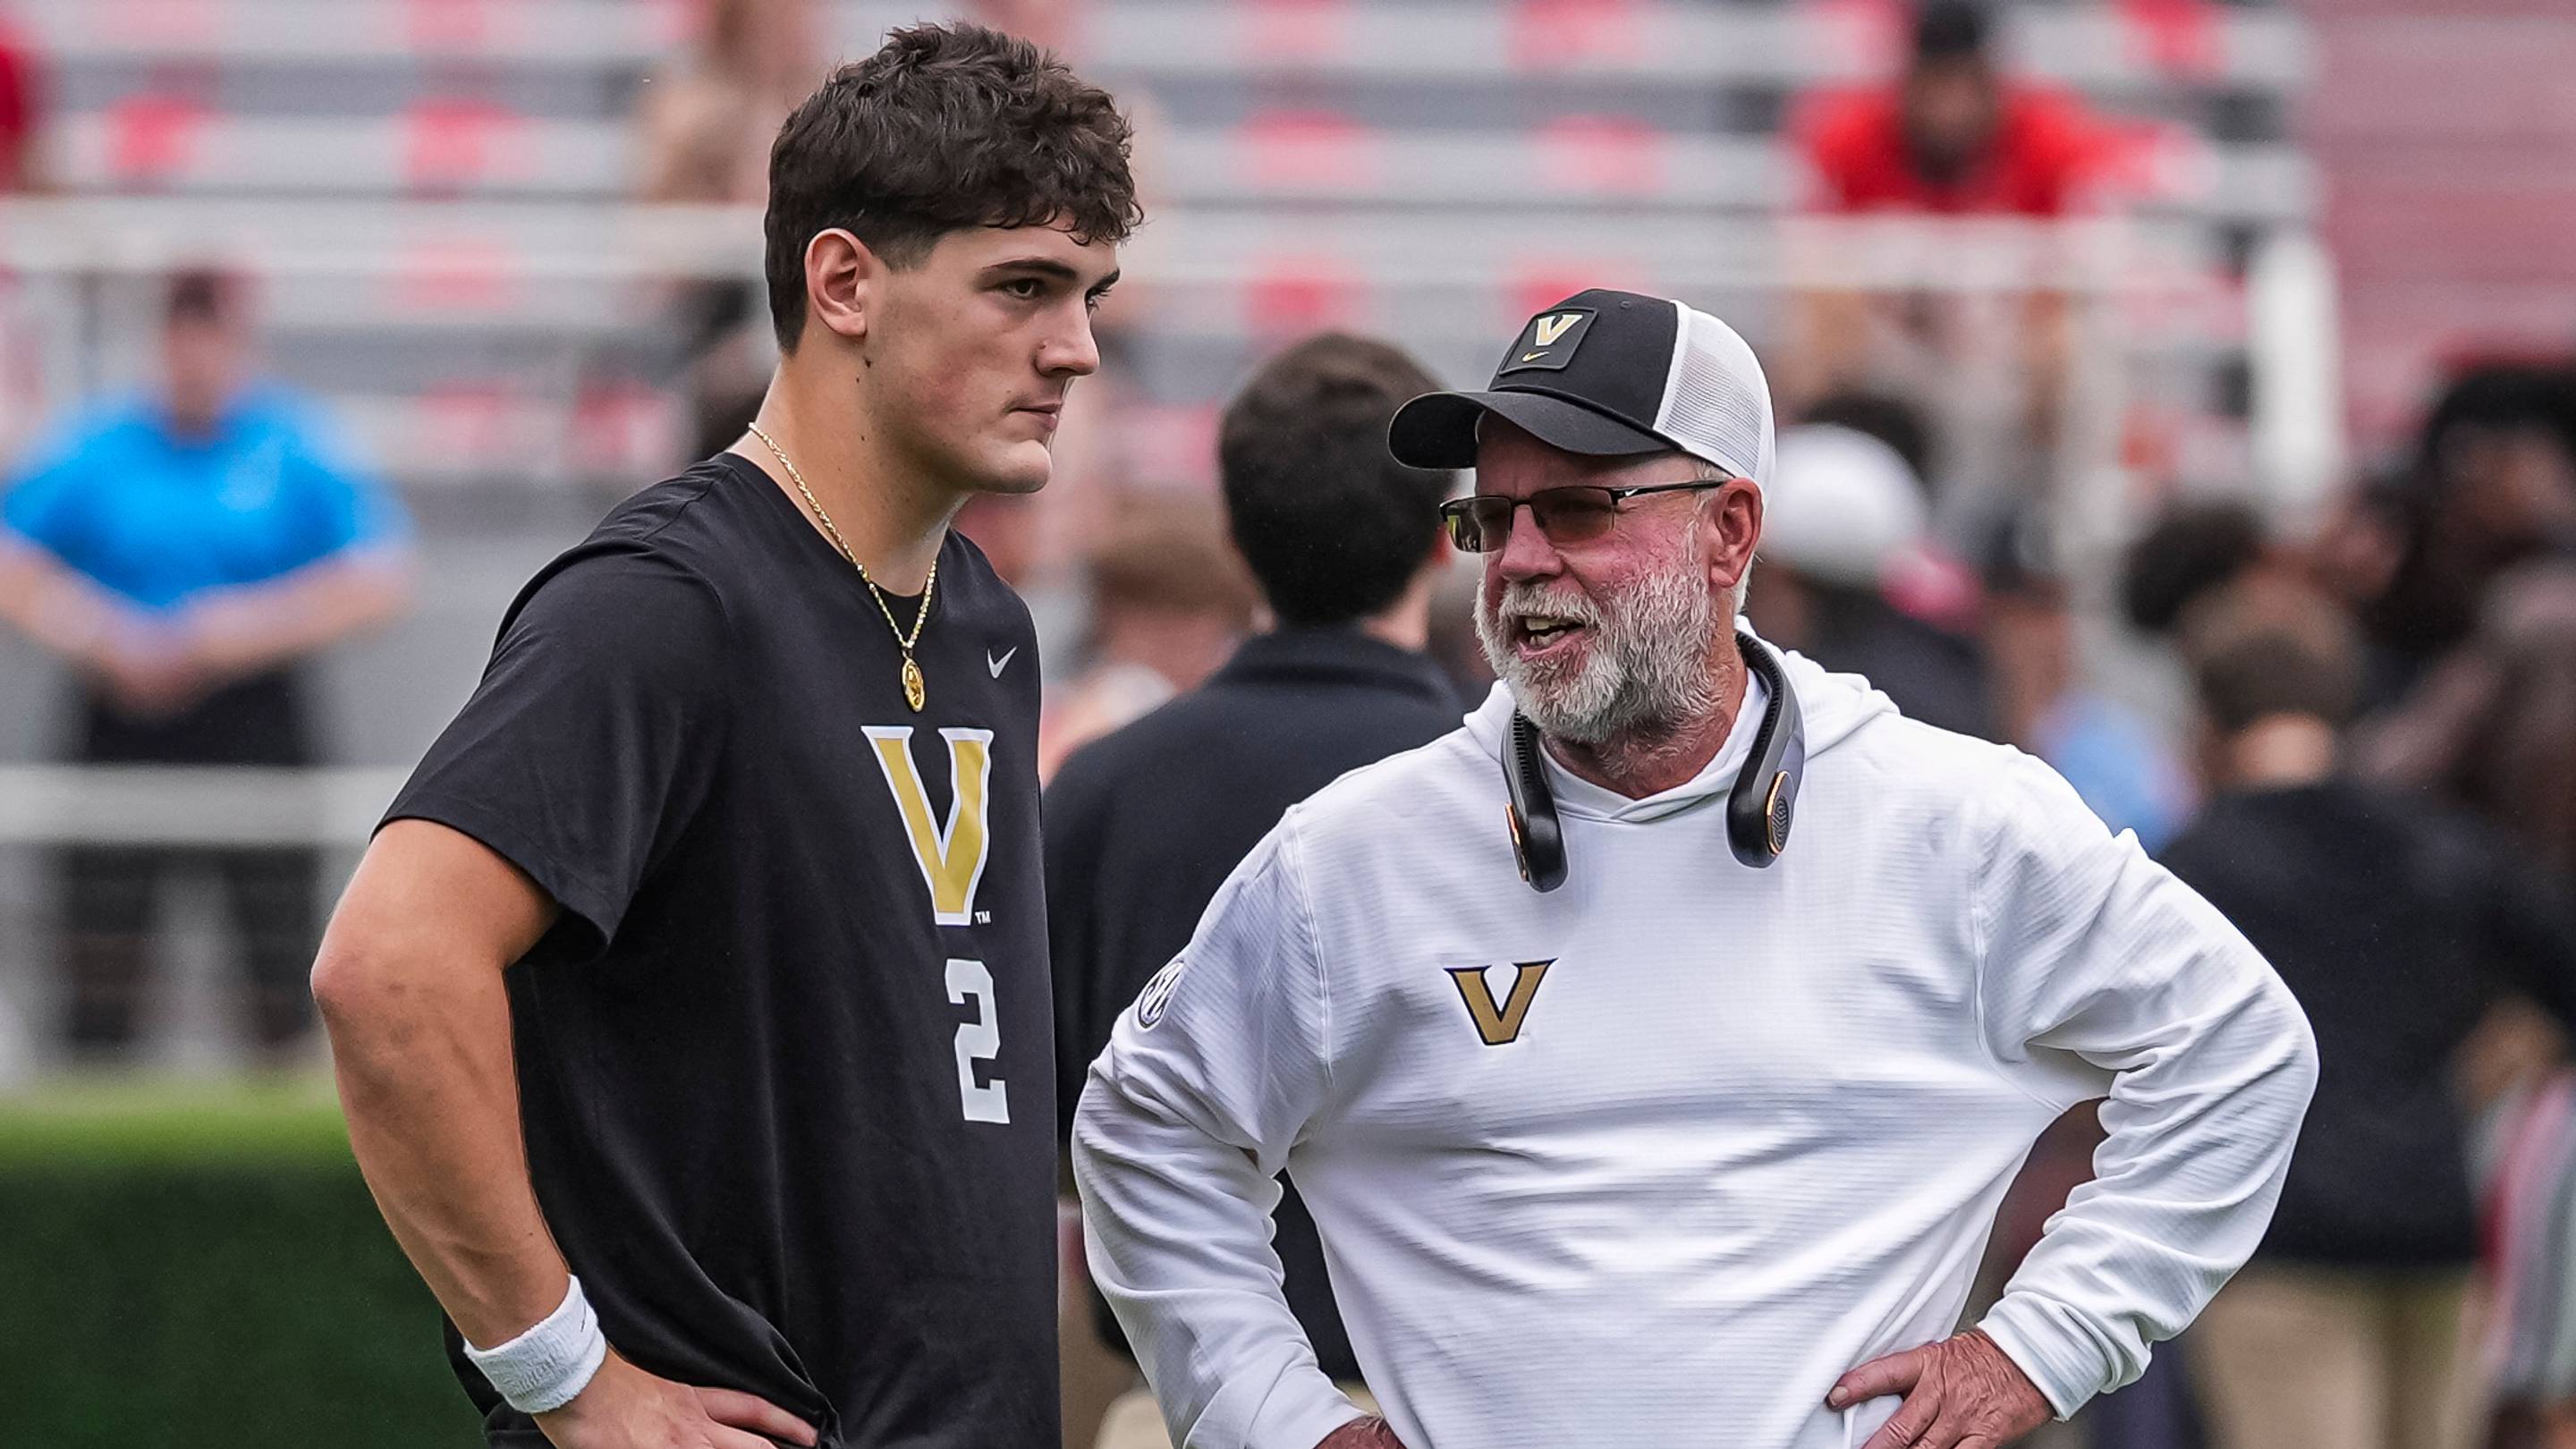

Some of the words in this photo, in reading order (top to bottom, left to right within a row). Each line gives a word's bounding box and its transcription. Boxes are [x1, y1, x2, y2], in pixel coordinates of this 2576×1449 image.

[1535, 314, 1583, 346] V
[861, 725, 994, 926] V
[975, 911, 991, 924] TM
[945, 958, 1010, 1123] 2
[1443, 957, 1559, 1046] V
